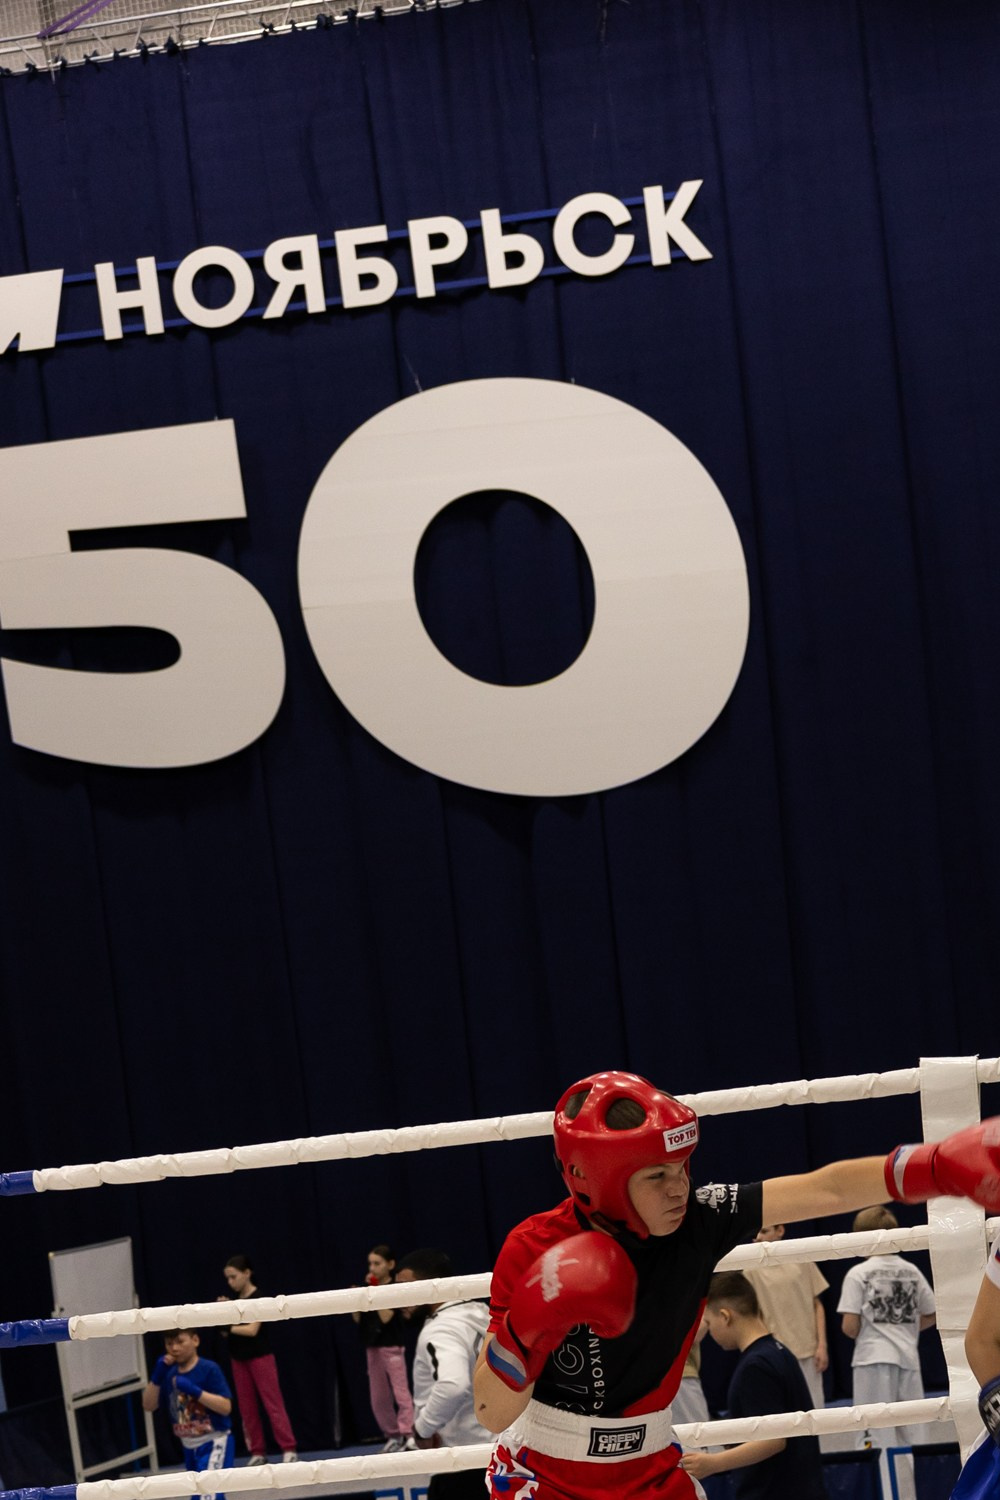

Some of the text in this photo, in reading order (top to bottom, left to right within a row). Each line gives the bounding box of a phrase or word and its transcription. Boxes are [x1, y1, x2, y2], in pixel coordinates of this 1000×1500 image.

[95, 179, 713, 341] НОЯБРЬСК
[0, 377, 750, 797] 50
[667, 1133, 685, 1146] TOP
[598, 1431, 640, 1444] GREEN
[597, 1442, 633, 1453] HILL
